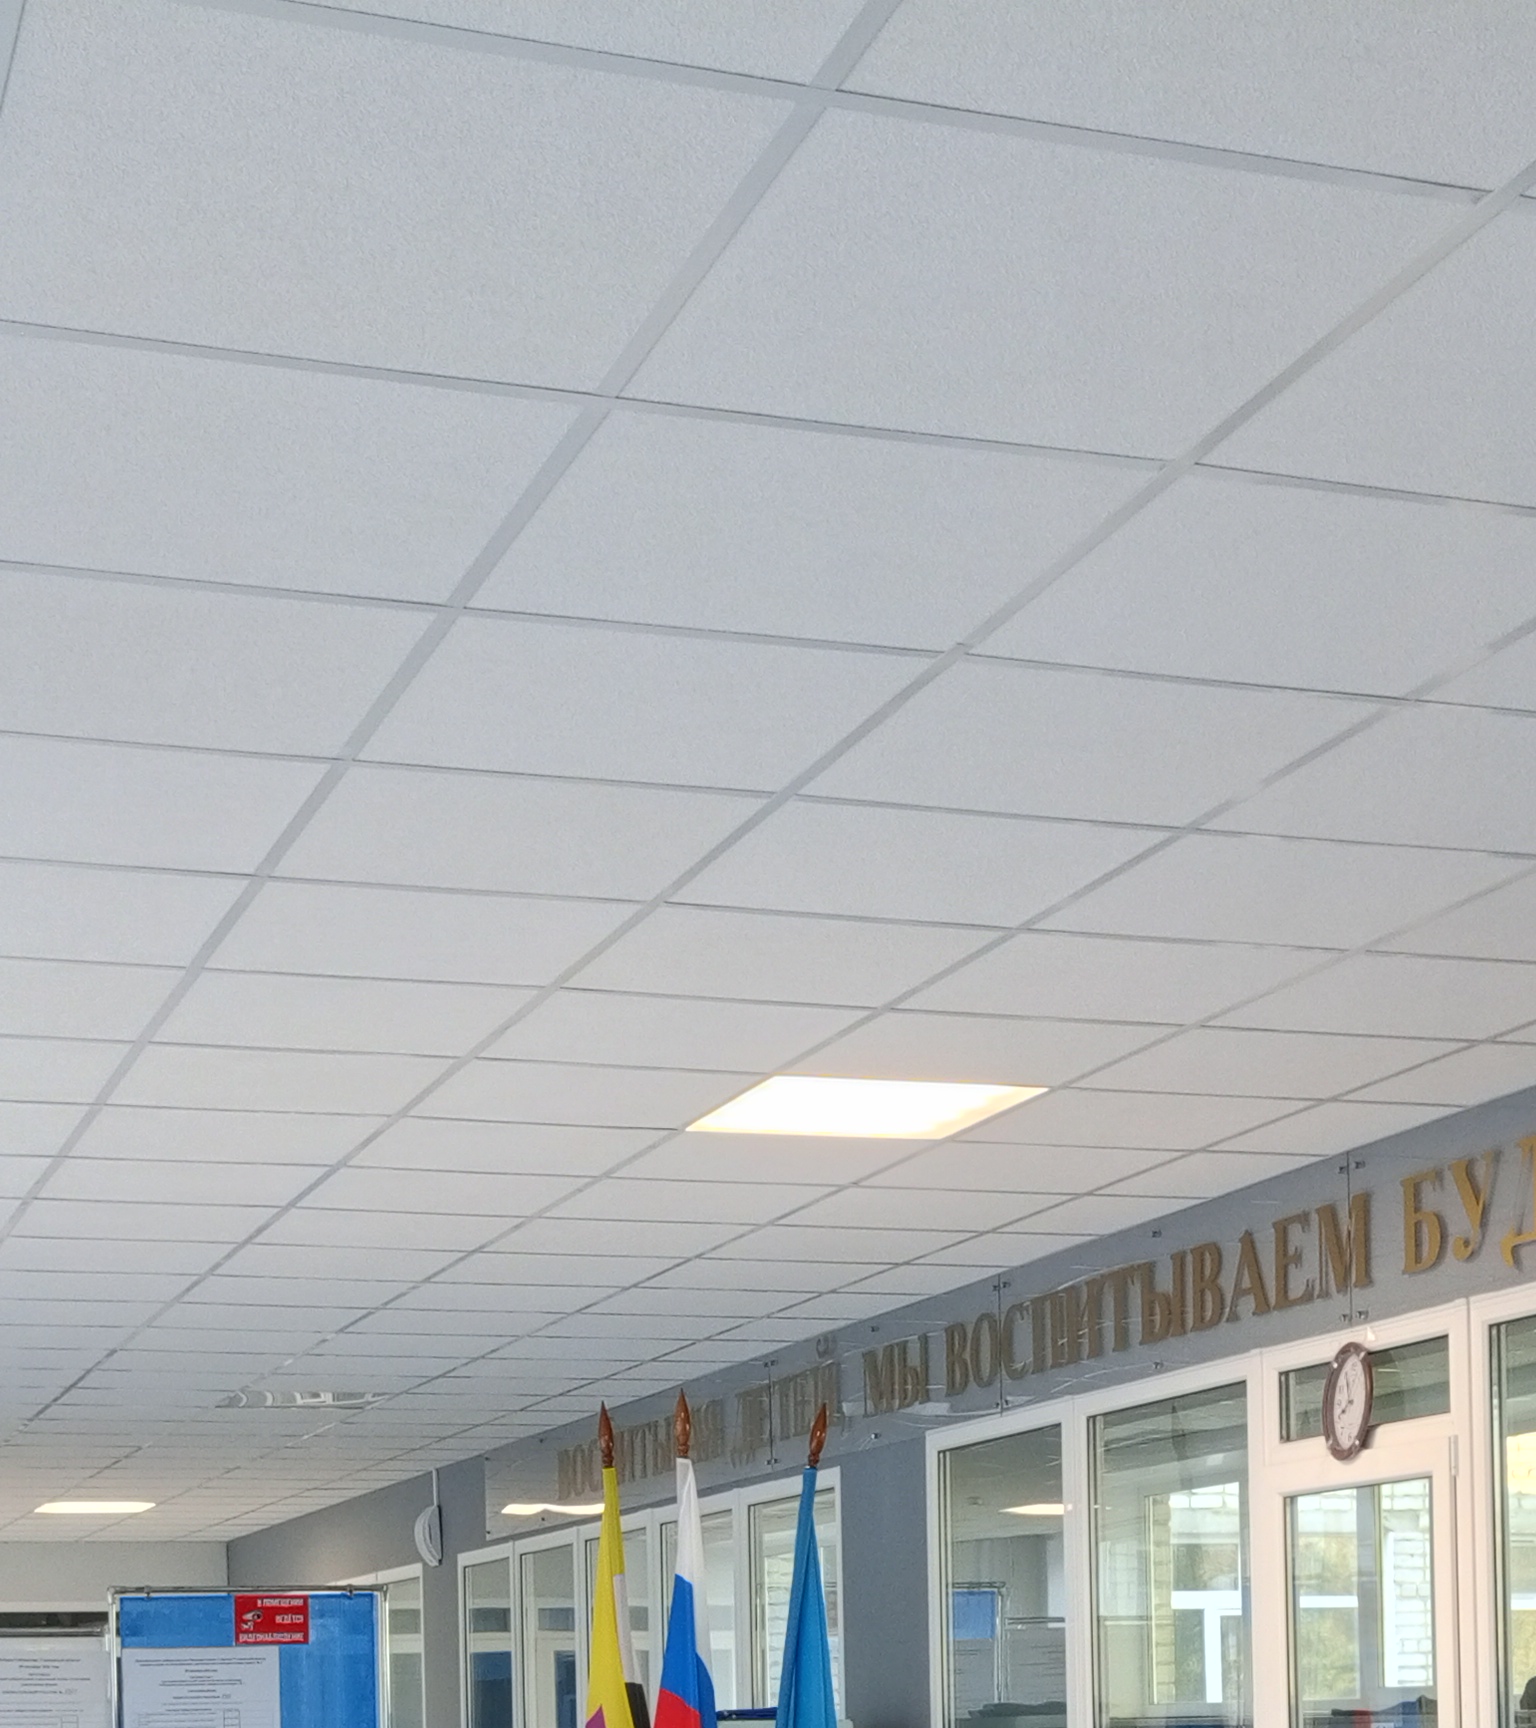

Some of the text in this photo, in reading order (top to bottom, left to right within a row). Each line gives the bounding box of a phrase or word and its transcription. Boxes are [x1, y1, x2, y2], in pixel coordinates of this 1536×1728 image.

[557, 1399, 727, 1501] ВОСИТЫАЯ
[862, 1334, 931, 1418] МЫ
[944, 1191, 1374, 1398] ВОСПИТЫВАЕМ
